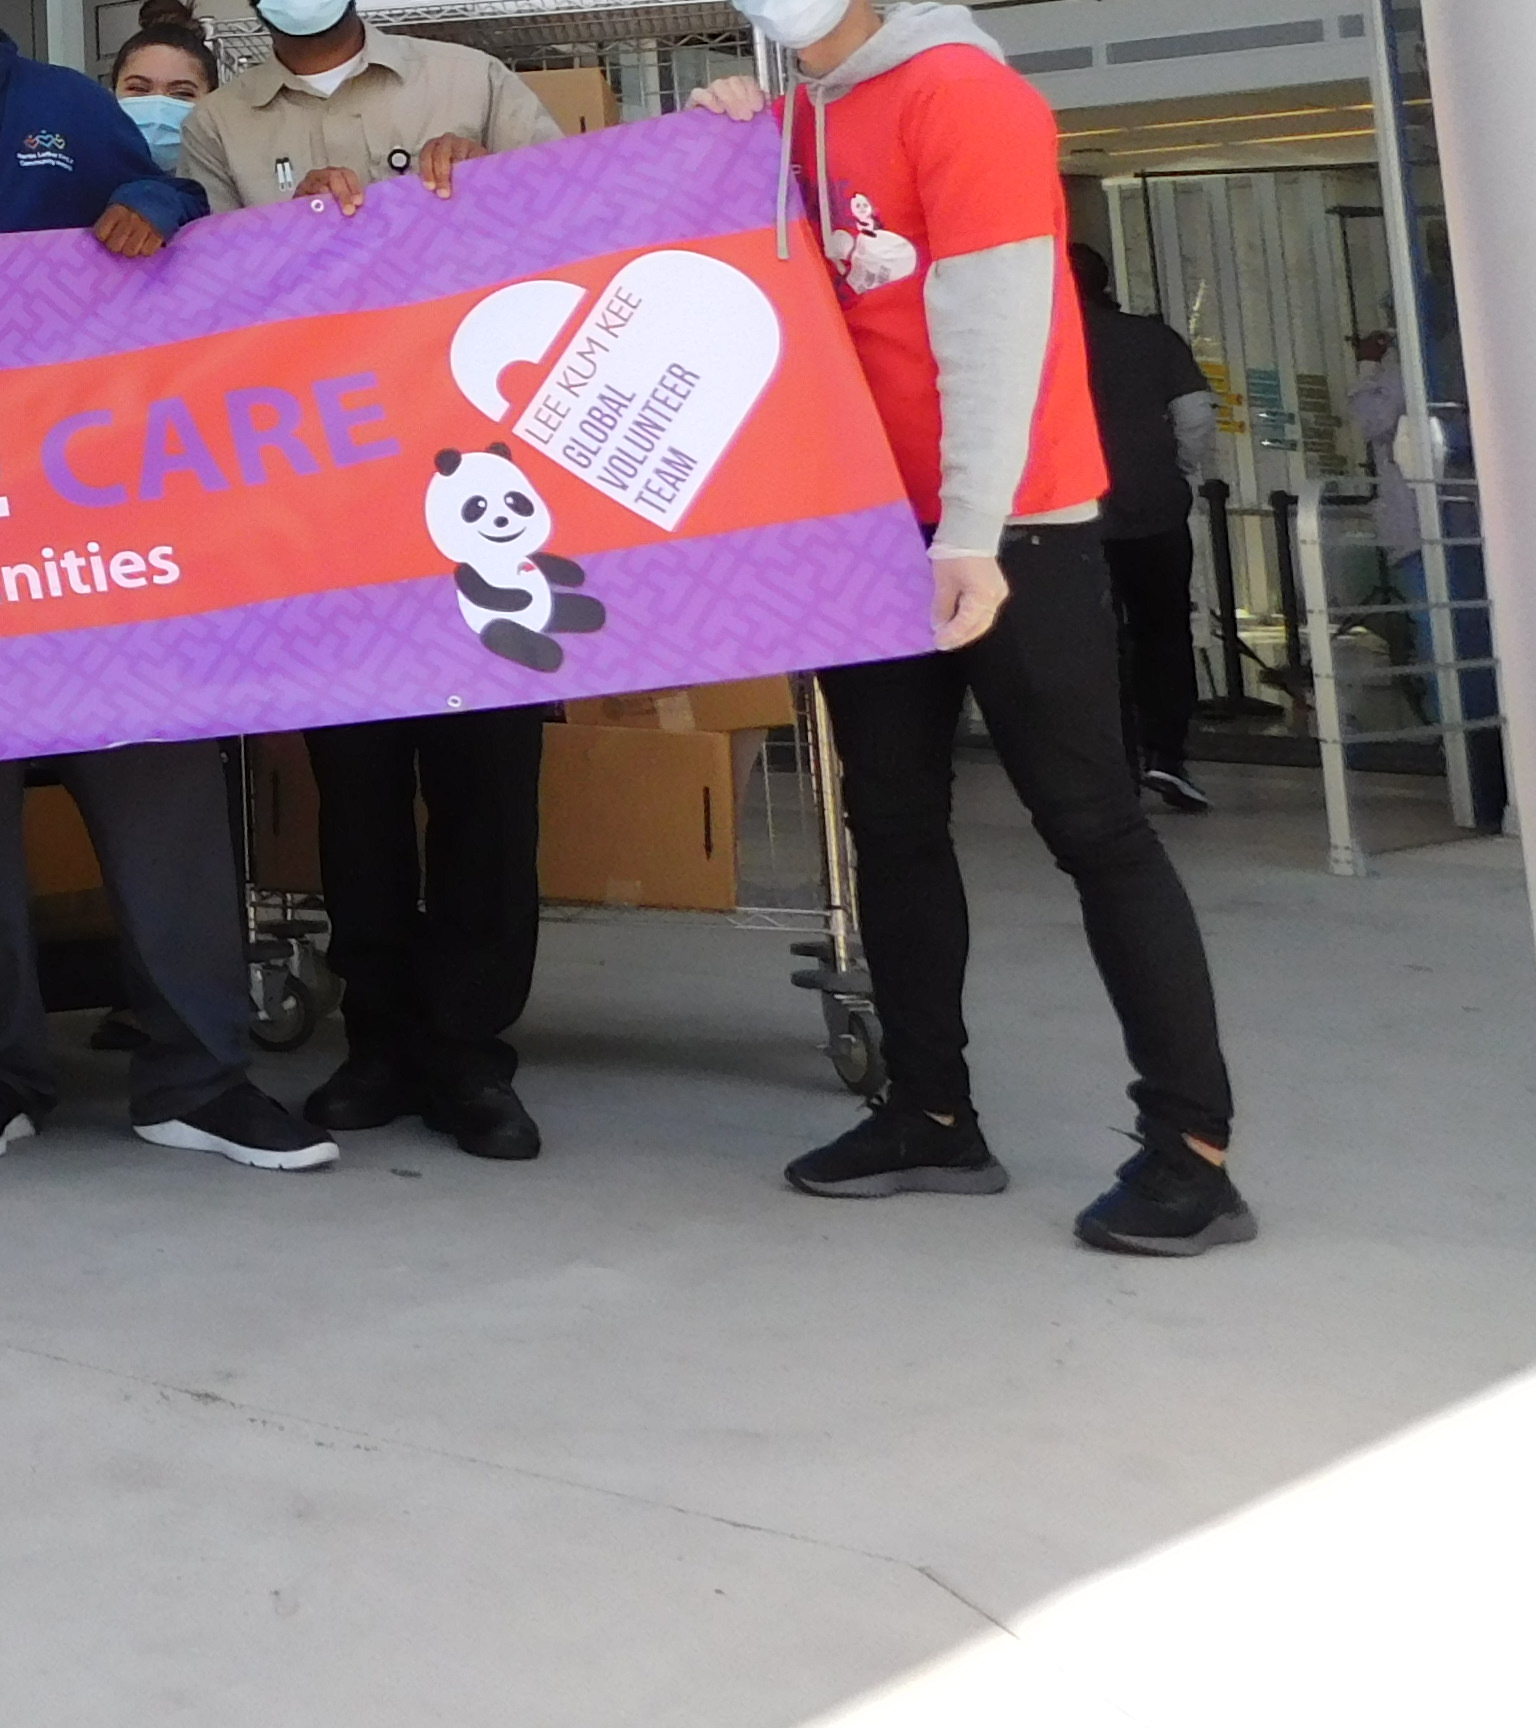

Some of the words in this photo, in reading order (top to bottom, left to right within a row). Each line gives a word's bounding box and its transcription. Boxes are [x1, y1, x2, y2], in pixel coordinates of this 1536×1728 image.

[525, 394, 571, 446] LEE
[556, 336, 610, 398] KUM
[595, 286, 642, 339] KEE
[562, 384, 637, 469] GLOBAL
[597, 363, 700, 491] VOLUNTEER
[39, 371, 402, 508] CARE
[634, 446, 698, 514] TEAM
